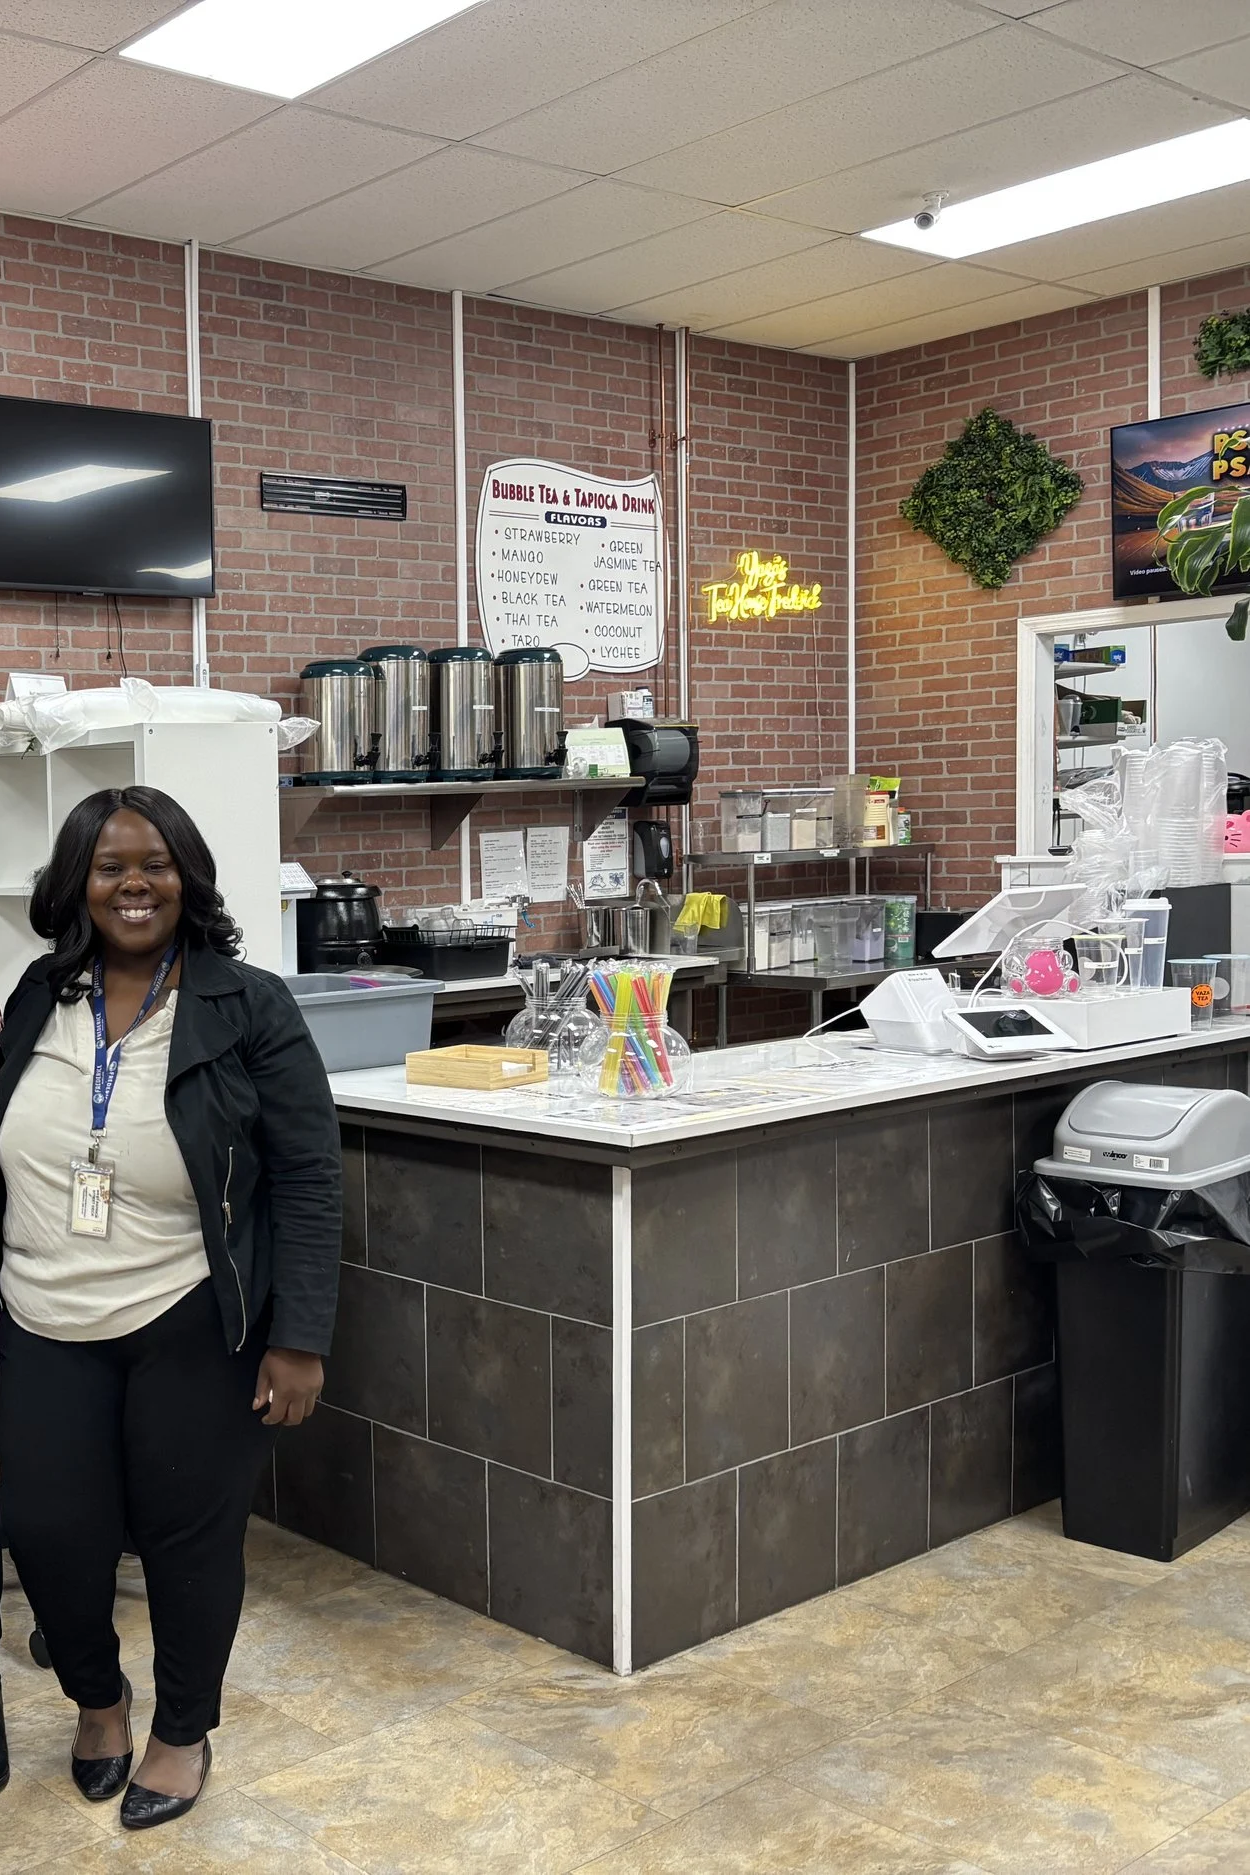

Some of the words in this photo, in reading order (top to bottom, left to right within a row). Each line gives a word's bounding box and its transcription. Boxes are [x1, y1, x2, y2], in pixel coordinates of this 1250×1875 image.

[492, 479, 535, 503] BUBBLE
[539, 484, 558, 505] TEA
[563, 490, 570, 505] &
[575, 488, 618, 511] TAPIOCA
[622, 493, 654, 514] DRINK
[550, 513, 602, 526] FLAVORS
[505, 528, 580, 545] STRAWBERRY
[610, 541, 643, 554] GREEN
[502, 549, 543, 563] MANGO
[594, 556, 638, 571] JASMINE
[643, 560, 662, 572] TEA
[498, 570, 558, 585] HONEYDEW
[588, 579, 622, 593] GREEN
[627, 582, 648, 594] TEA
[502, 592, 538, 605] BLACK
[545, 594, 566, 607] TEA
[586, 601, 652, 616] WATERMELON
[505, 613, 530, 626] THAI
[537, 615, 558, 627] TEA
[595, 624, 642, 638] COCONUT
[512, 635, 540, 648] TARO
[601, 646, 640, 659] LYCHEE
